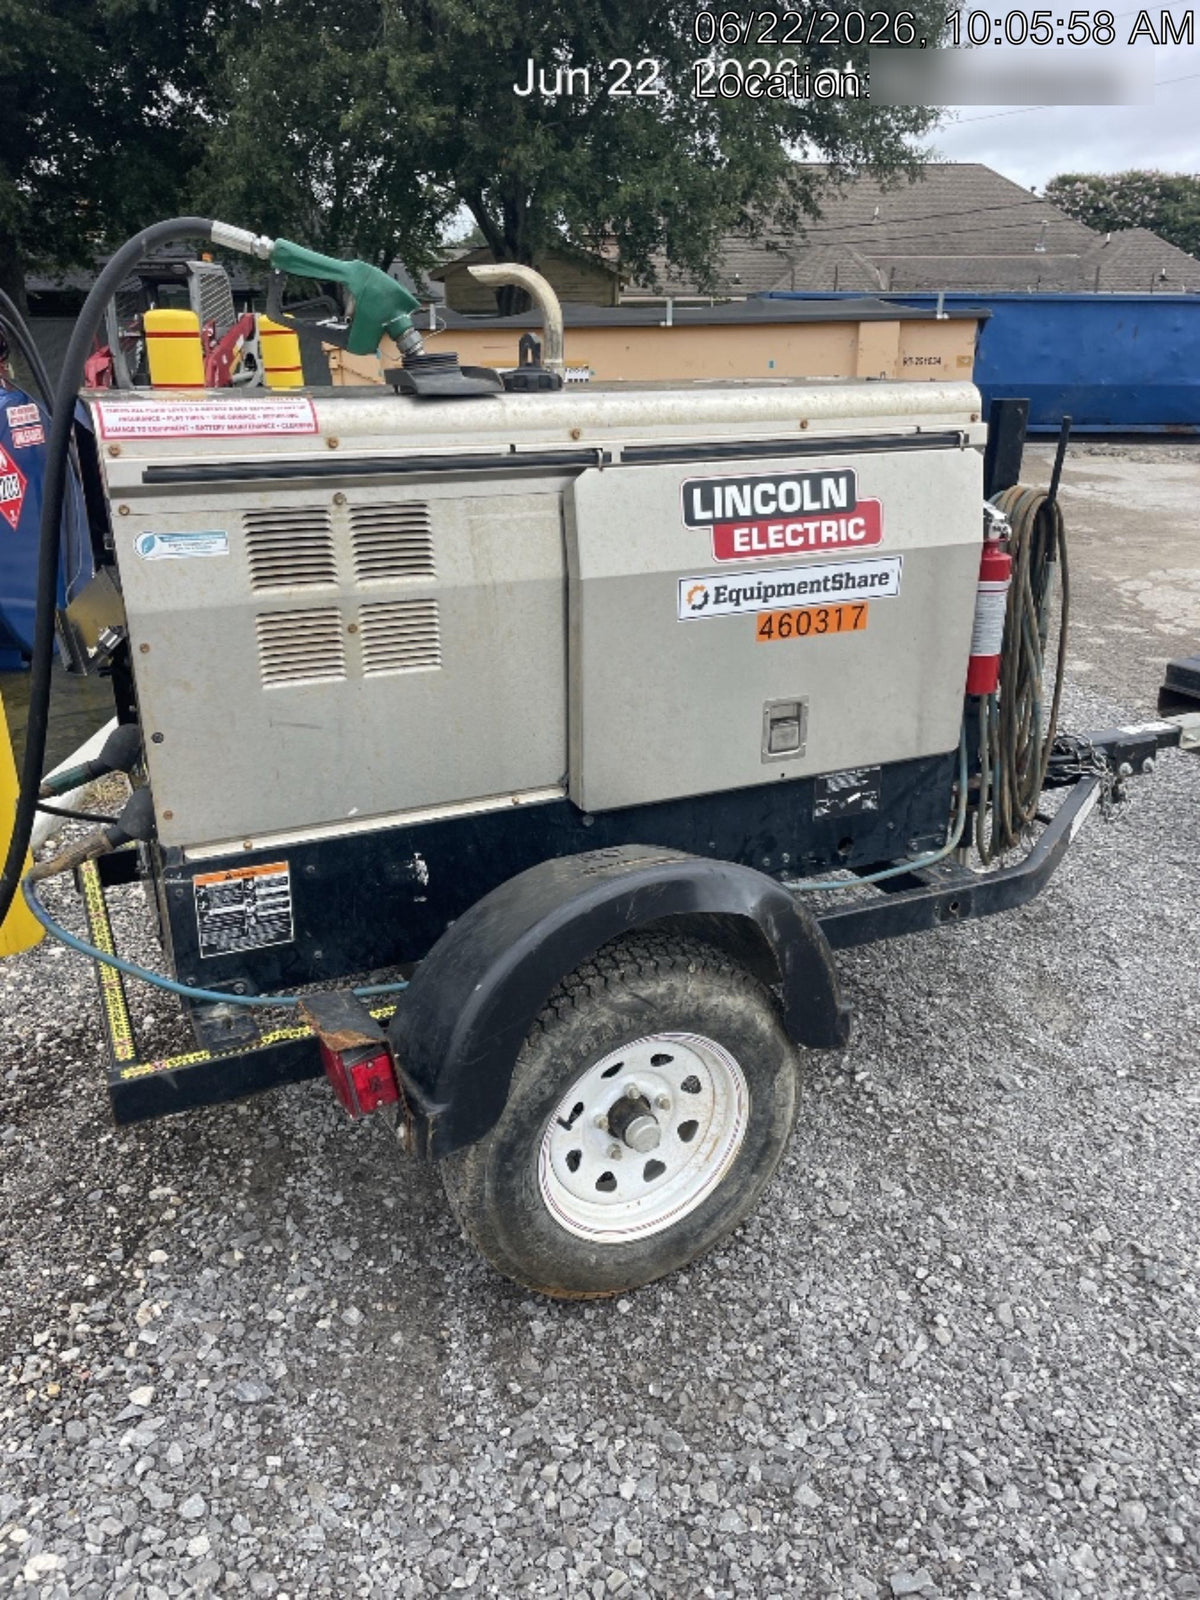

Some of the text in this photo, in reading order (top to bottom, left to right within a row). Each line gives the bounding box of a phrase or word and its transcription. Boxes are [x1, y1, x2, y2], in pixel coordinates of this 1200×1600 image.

[692, 476, 847, 520] LINCOLN
[733, 517, 866, 552] ELECTRIC
[713, 571, 890, 607] EquipmentShare
[758, 605, 865, 639] 460317
